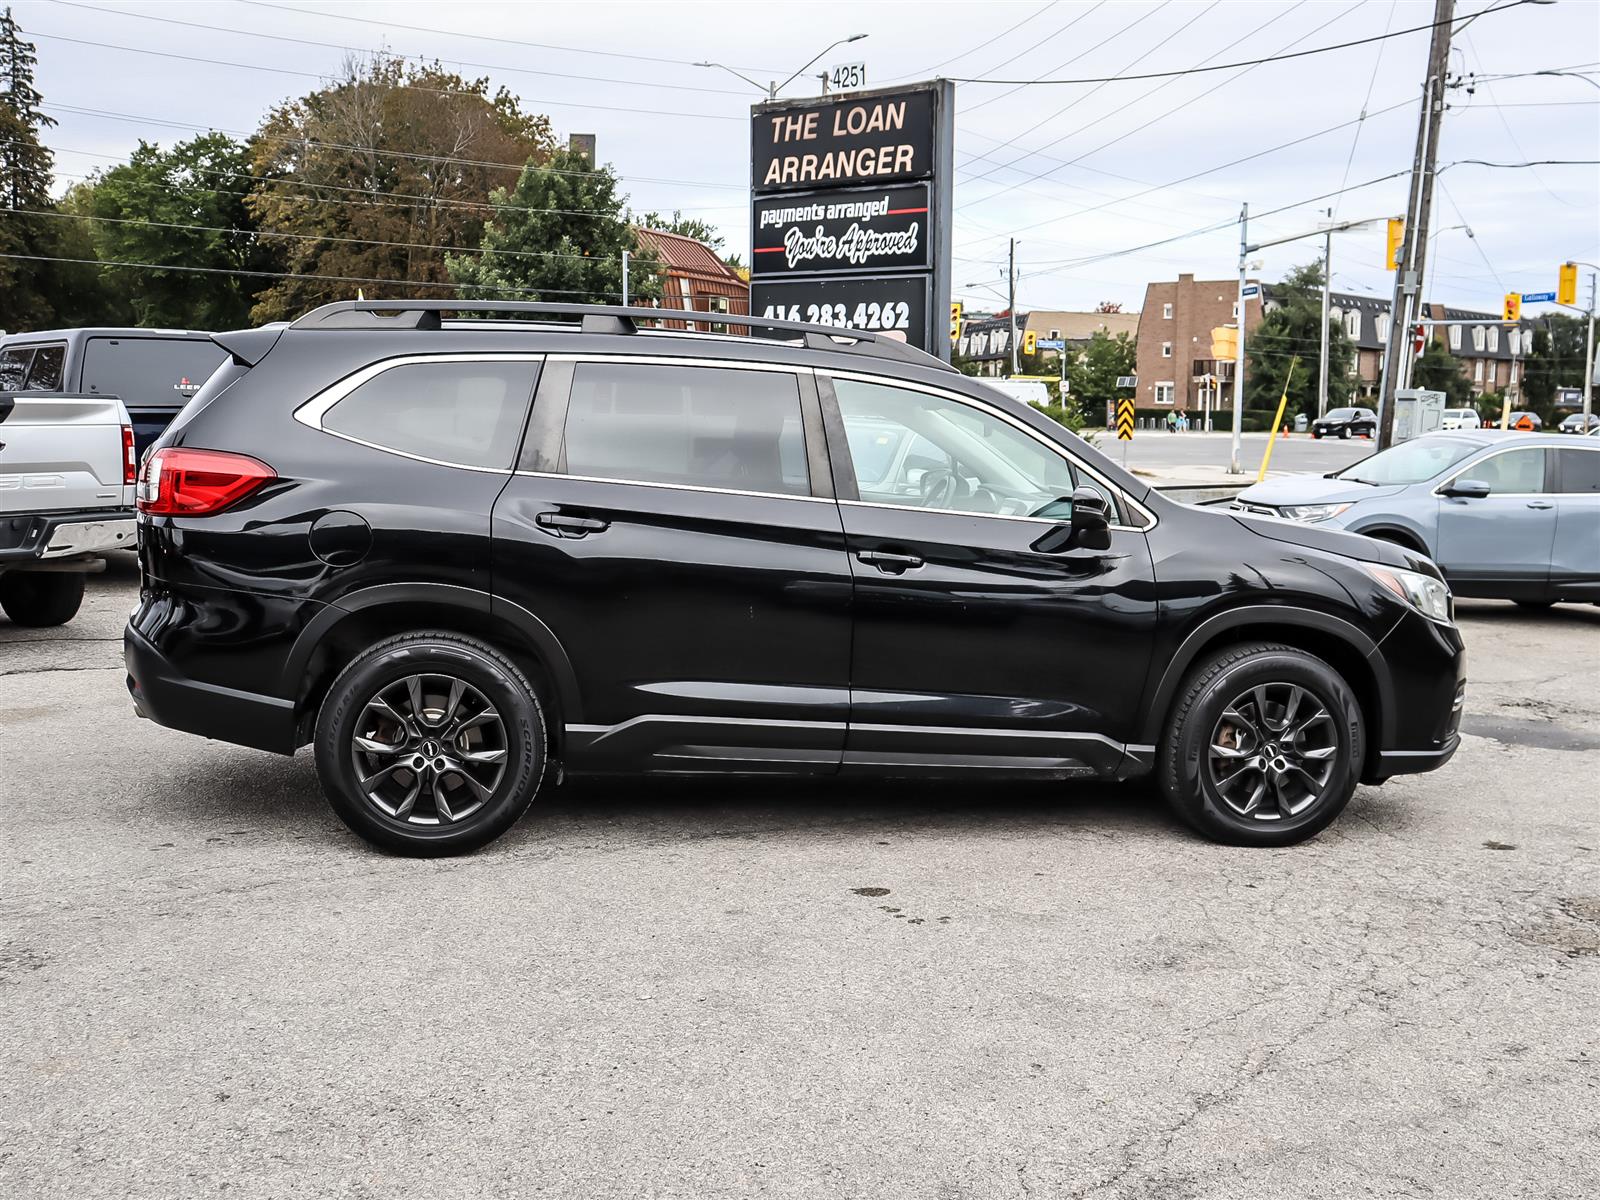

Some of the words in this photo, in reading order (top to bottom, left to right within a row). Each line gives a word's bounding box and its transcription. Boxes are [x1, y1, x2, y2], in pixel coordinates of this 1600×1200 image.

[833, 64, 866, 89] 4251
[771, 112, 820, 144] THE
[832, 101, 906, 137] LOAN
[763, 144, 914, 185] ARRANGER
[760, 203, 825, 228] payments
[826, 196, 889, 221] arranged
[784, 225, 836, 268] You're
[836, 222, 918, 264] Approved
[763, 301, 910, 331] 416283.4262
[512, 718, 532, 803] SCORPION
